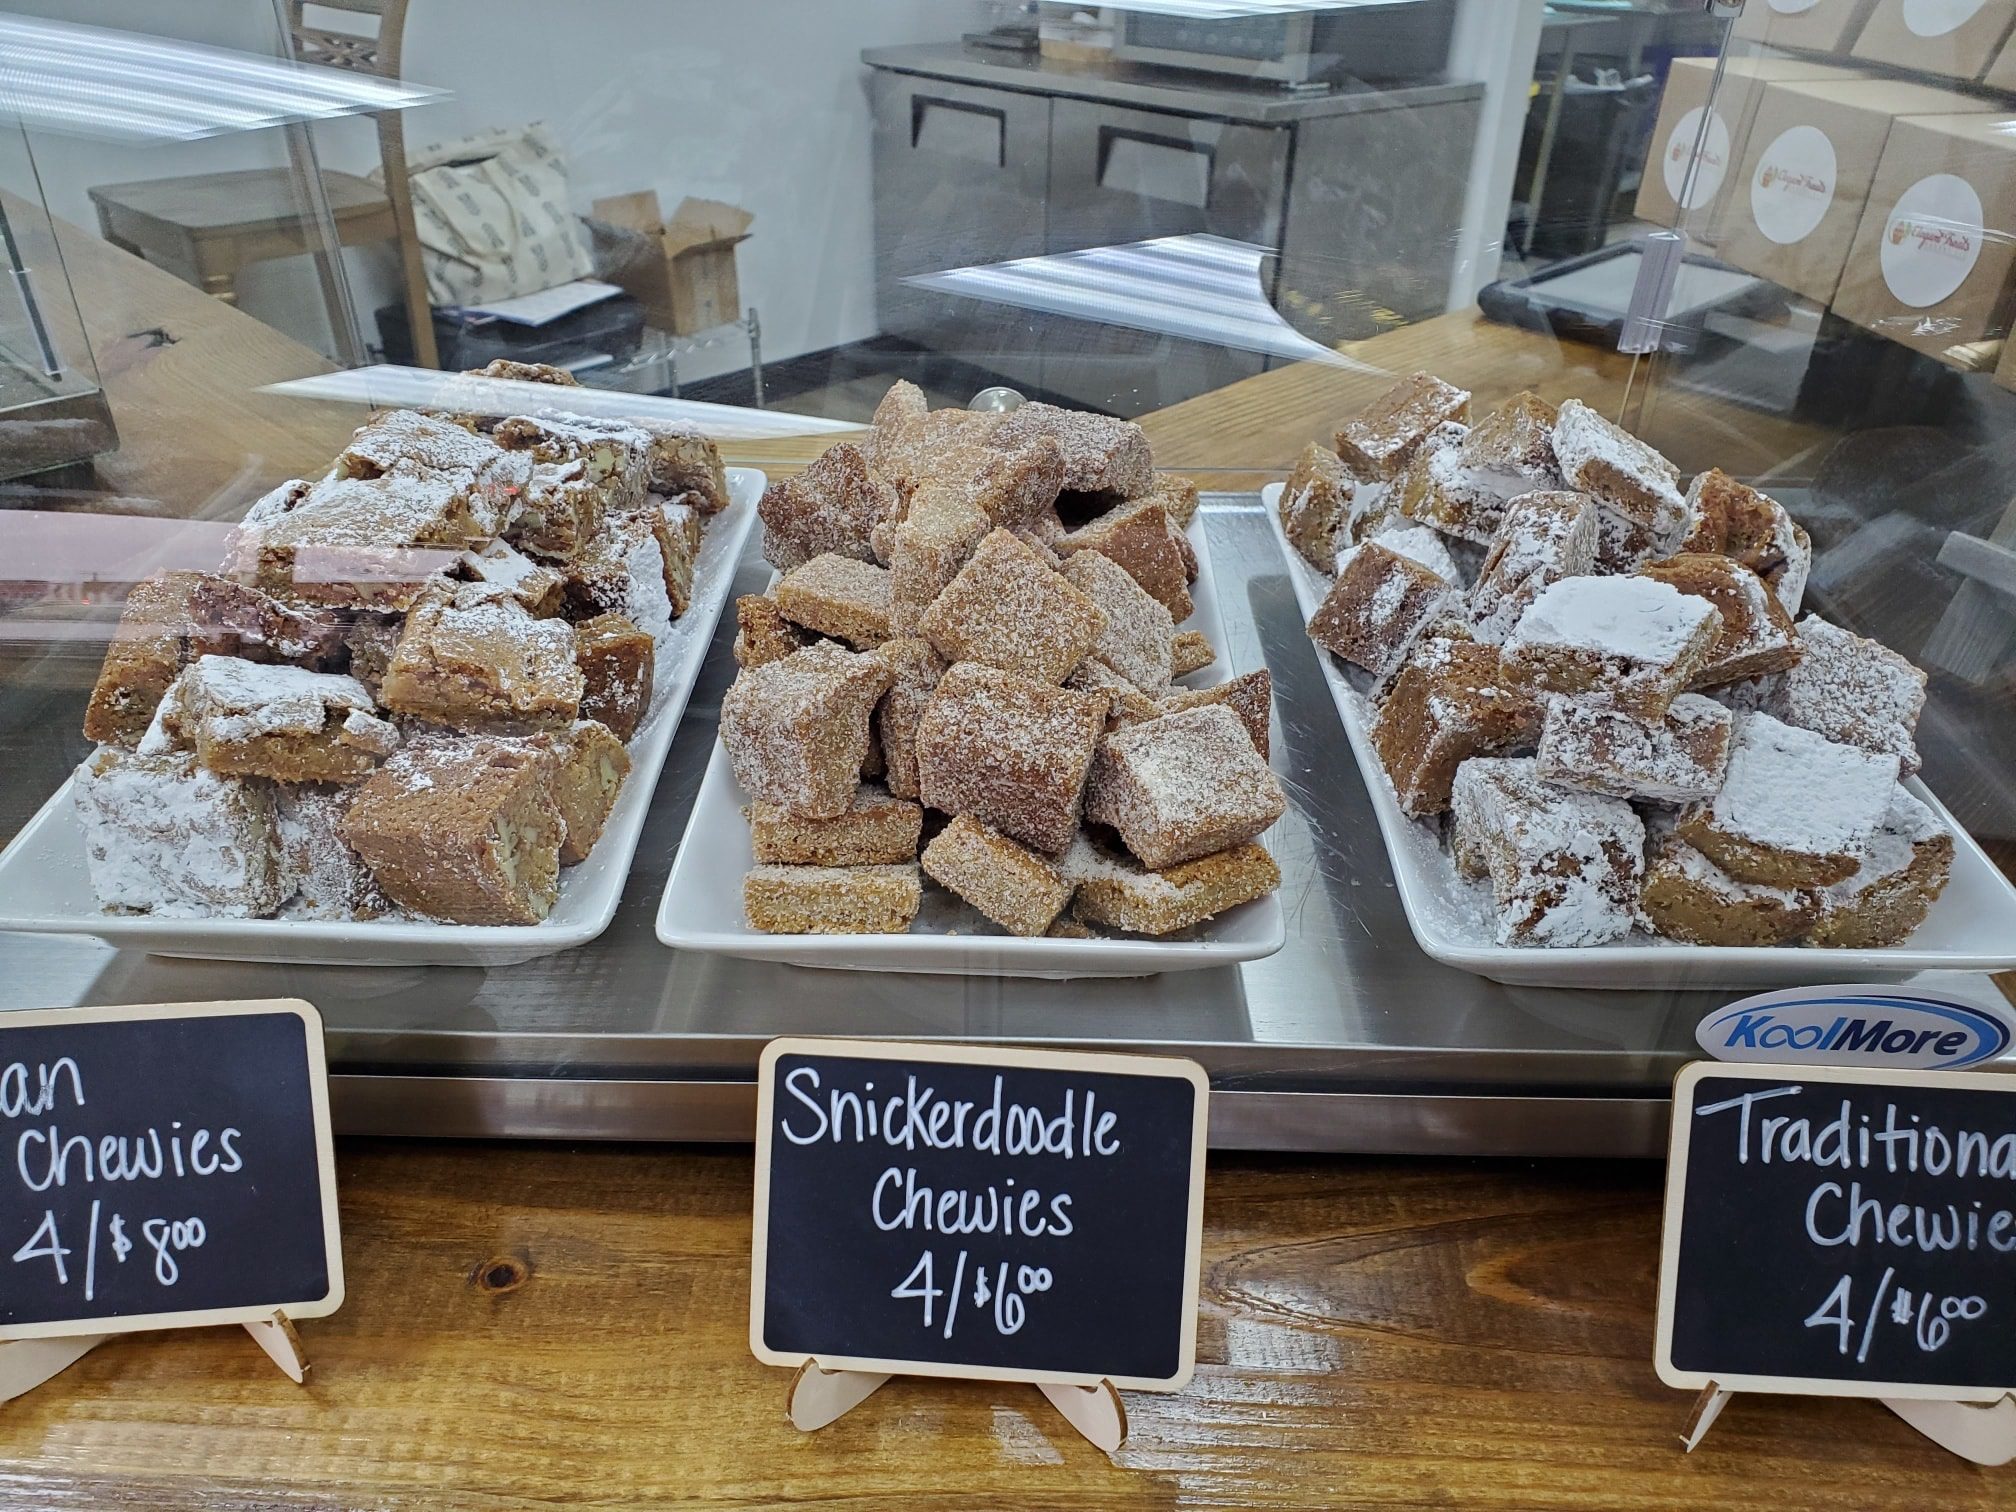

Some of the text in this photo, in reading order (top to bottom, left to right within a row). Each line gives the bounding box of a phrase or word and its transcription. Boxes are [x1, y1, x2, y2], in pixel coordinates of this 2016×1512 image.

[1724, 1014, 1968, 1056] KoolMore
[781, 1067, 1121, 1160] Snickerdoodle
[18, 1122, 243, 1192] Chewies
[872, 1167, 1074, 1237] Chewies
[1805, 1182, 2016, 1252] Chewie
